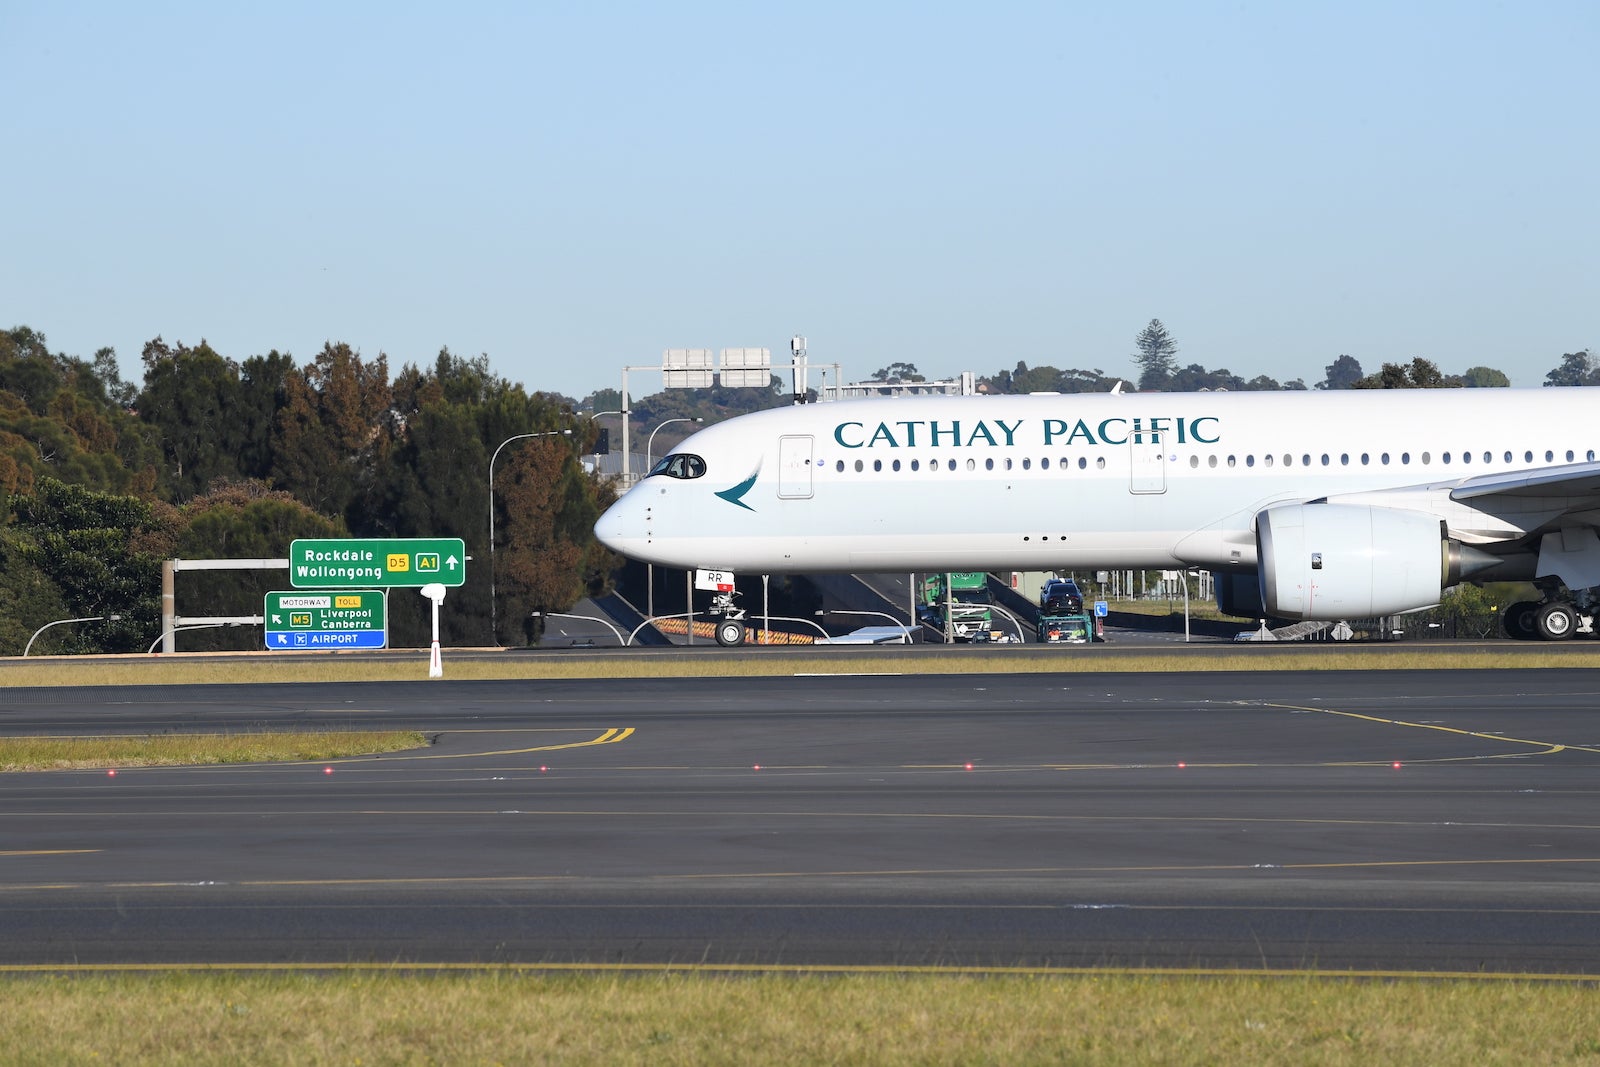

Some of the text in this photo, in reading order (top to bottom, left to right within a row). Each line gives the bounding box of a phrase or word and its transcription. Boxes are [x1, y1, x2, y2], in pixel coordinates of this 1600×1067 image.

[834, 417, 1221, 448] CATHAY PACIFIC
[305, 549, 373, 561] Rockdale
[390, 557, 436, 568] D5 A1
[297, 566, 382, 580] Wollongong
[708, 573, 722, 582] RR
[338, 598, 358, 606] TOLL
[320, 609, 372, 619] Liverpool
[293, 615, 309, 624] M5
[321, 620, 371, 629] Canberra
[311, 634, 358, 643] AIRPORT
